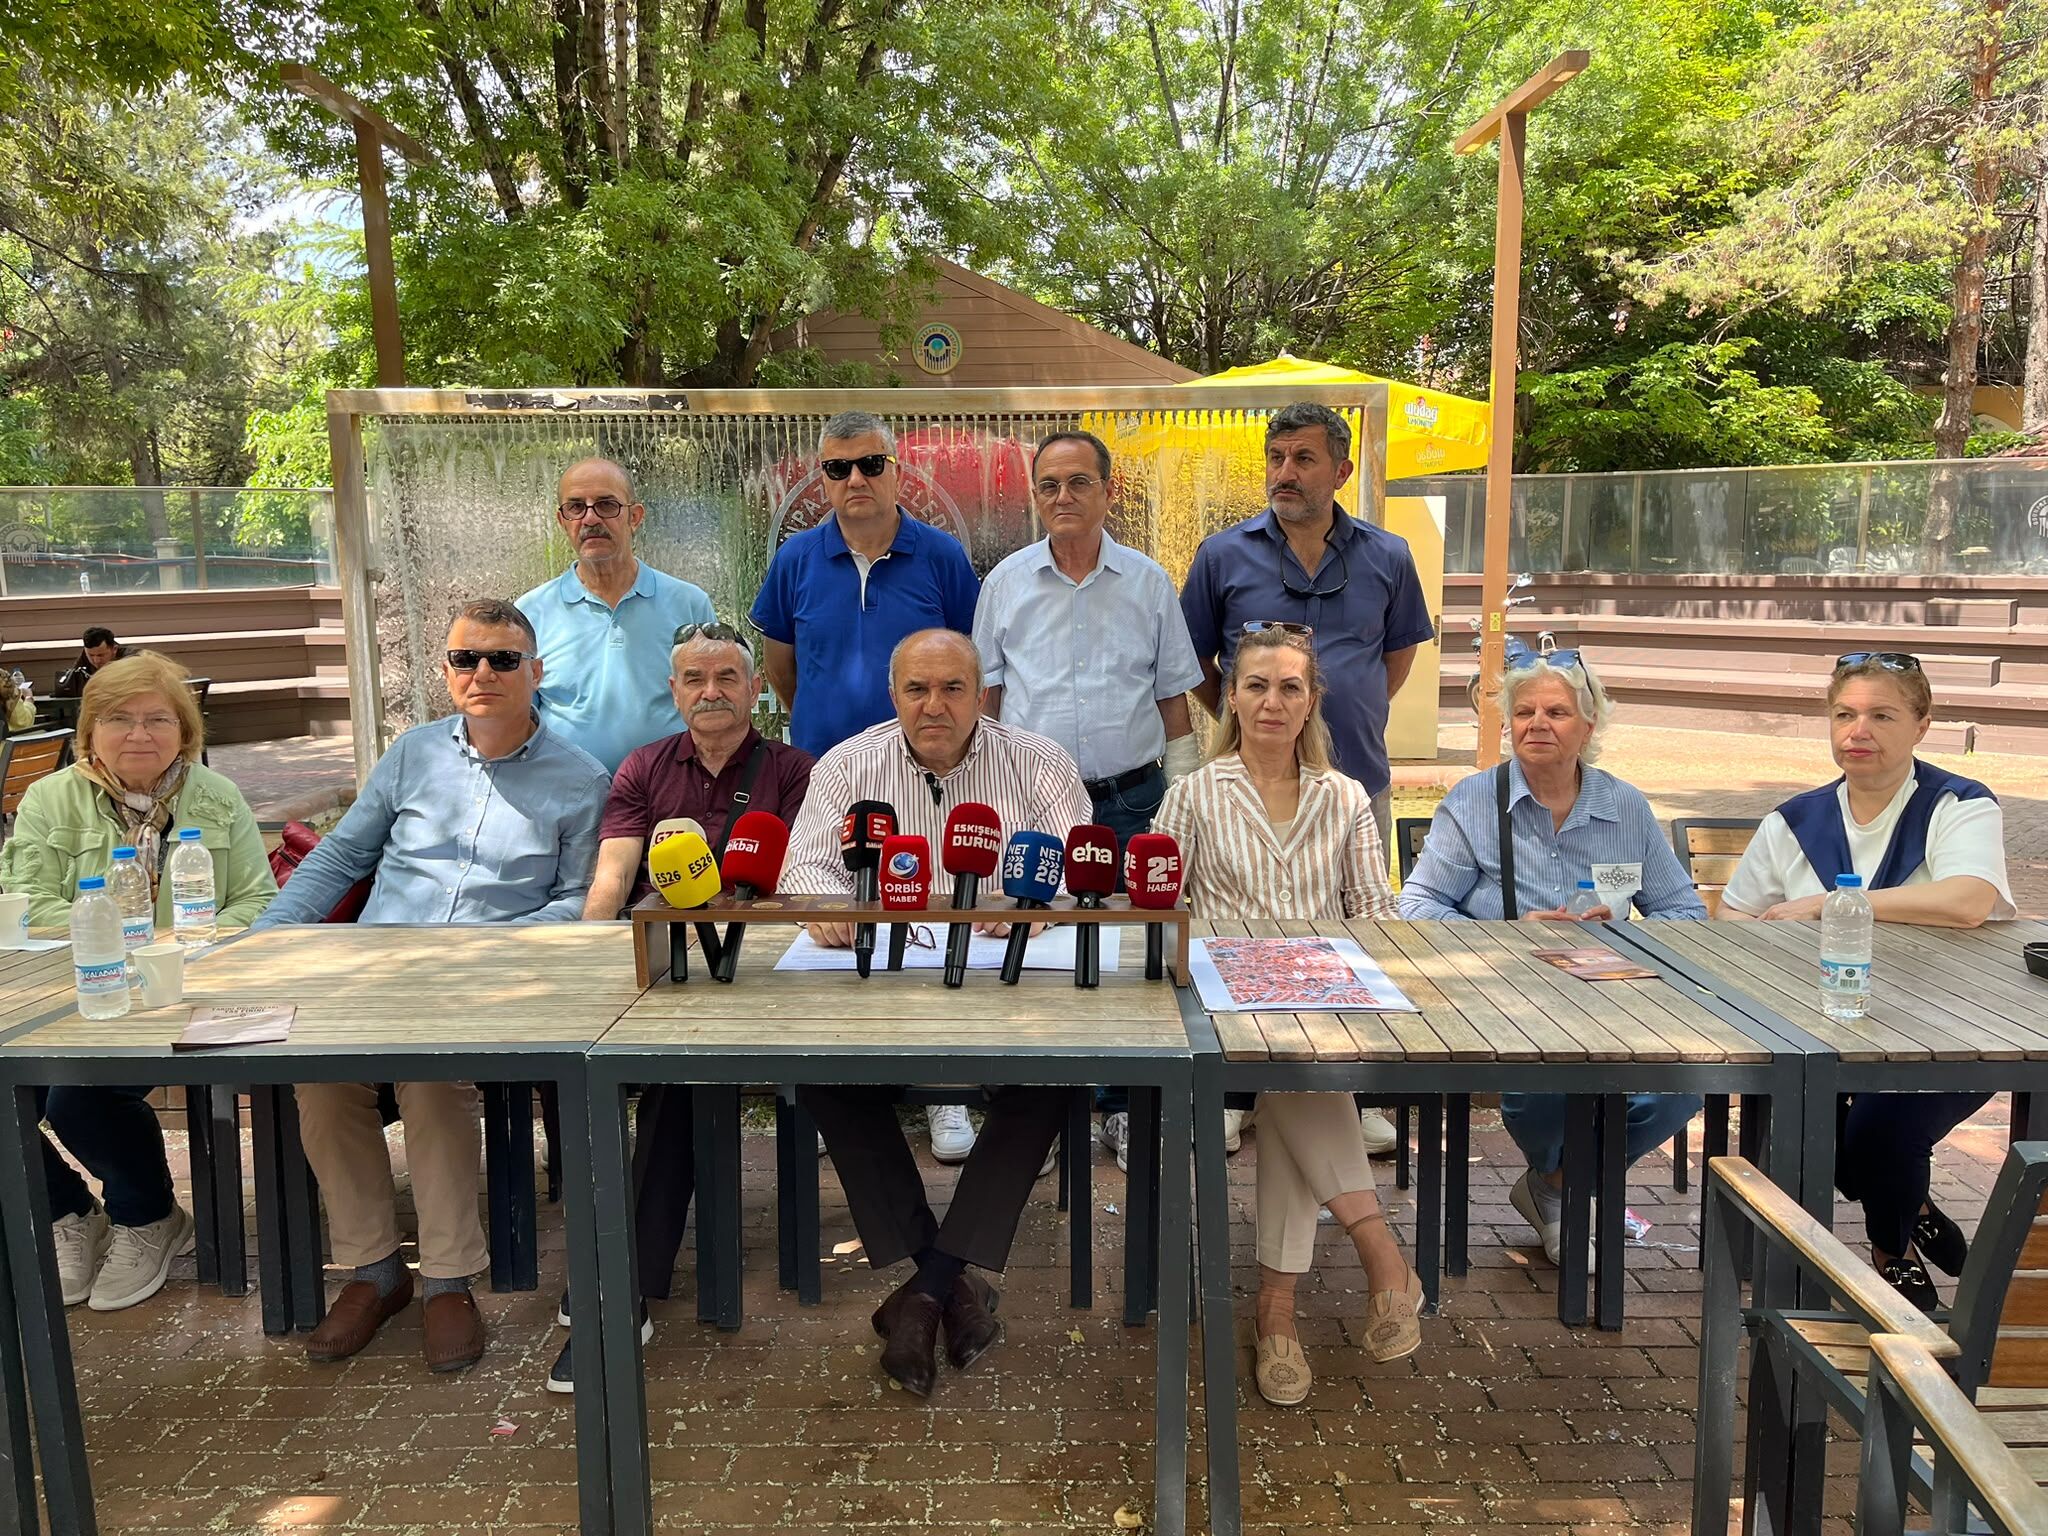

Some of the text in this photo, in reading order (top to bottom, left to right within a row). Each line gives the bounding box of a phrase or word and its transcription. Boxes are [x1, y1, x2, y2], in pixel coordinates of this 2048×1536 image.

[1007, 844, 1029, 855] NET
[1040, 846, 1062, 862] NET
[1072, 841, 1113, 864] eha
[688, 853, 713, 874] ES26
[1004, 863, 1025, 879] 26
[1147, 856, 1178, 883] 2E
[655, 870, 681, 884] ES26
[1034, 866, 1060, 886] 26
[884, 881, 922, 893] ORBİS
[1147, 883, 1178, 893] HABER
[889, 895, 917, 903] HABER
